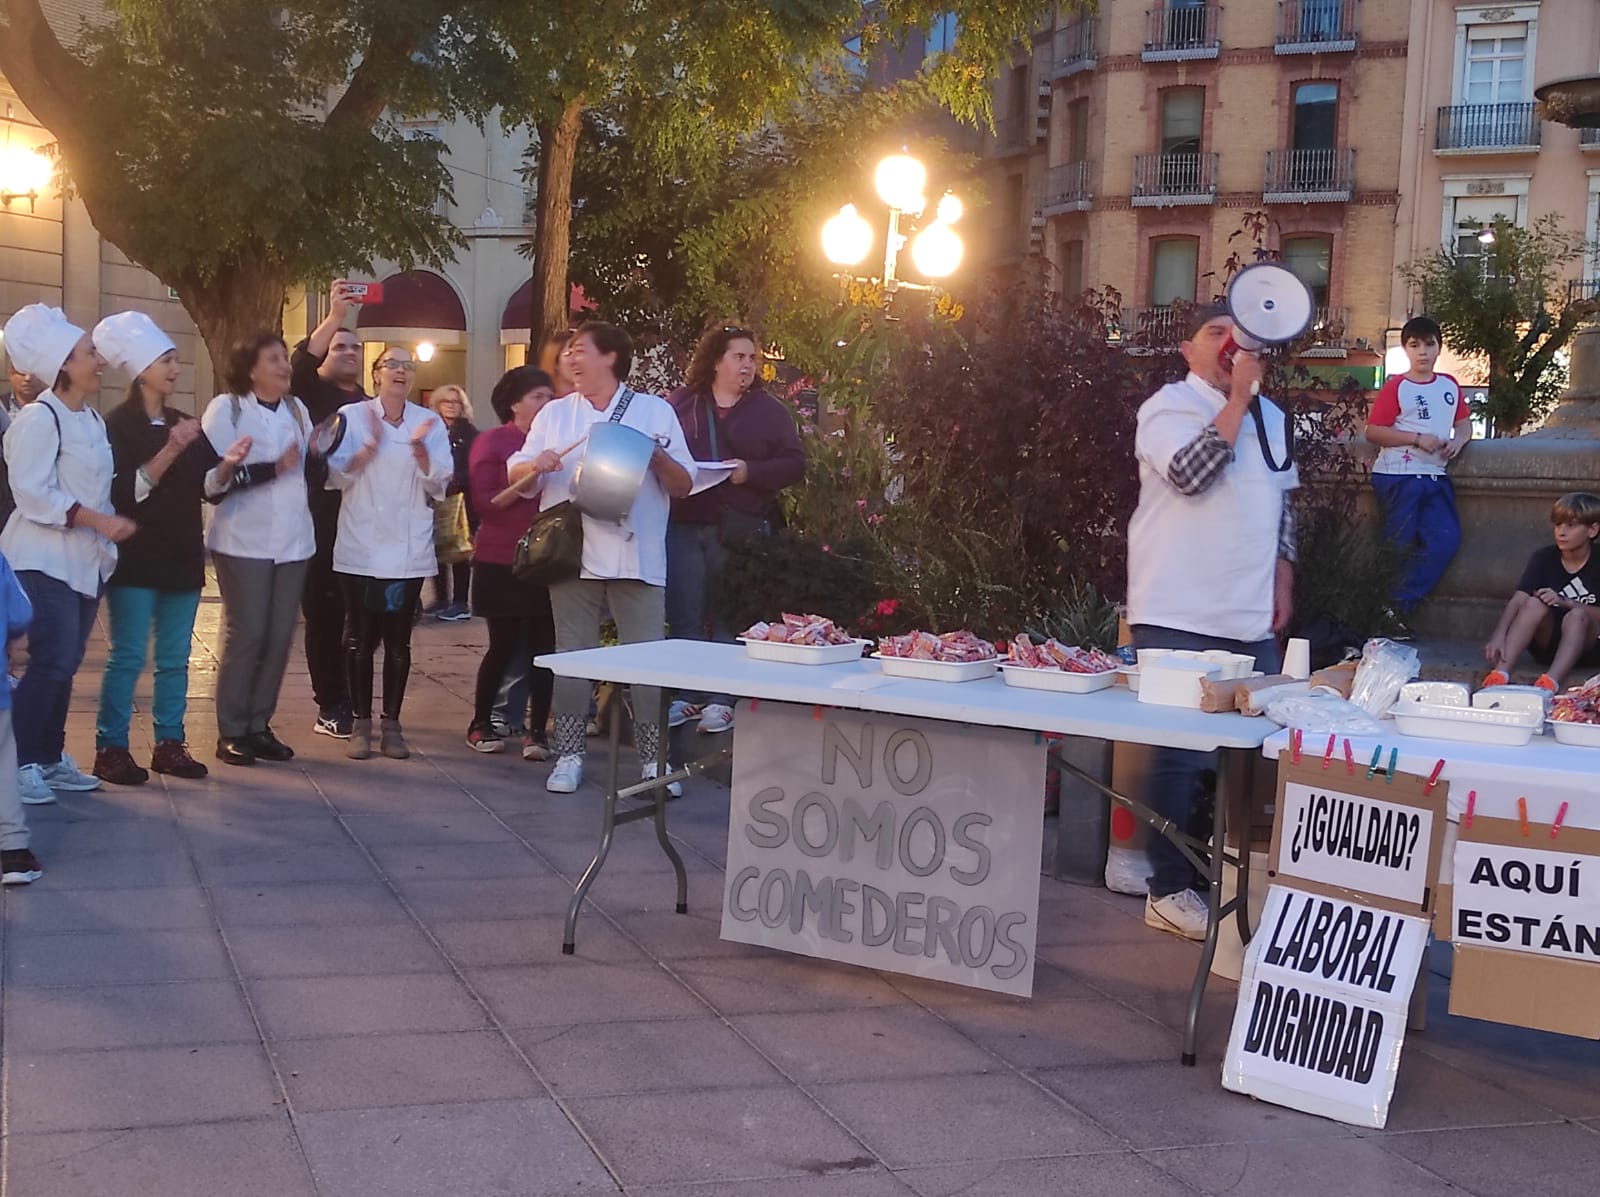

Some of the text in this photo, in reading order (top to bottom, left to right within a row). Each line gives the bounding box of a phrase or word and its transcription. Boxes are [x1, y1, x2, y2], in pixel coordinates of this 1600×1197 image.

[821, 721, 933, 796] NO
[745, 786, 993, 886] SOMOS
[1291, 793, 1420, 872] ¿IGUALDAD?
[1470, 857, 1582, 898] AQUÍ
[729, 866, 1028, 980] COMEDEROS
[1263, 893, 1405, 994] LABORAL
[1458, 908, 1600, 956] ESTÁN
[1243, 980, 1384, 1085] DIGNIDAD
